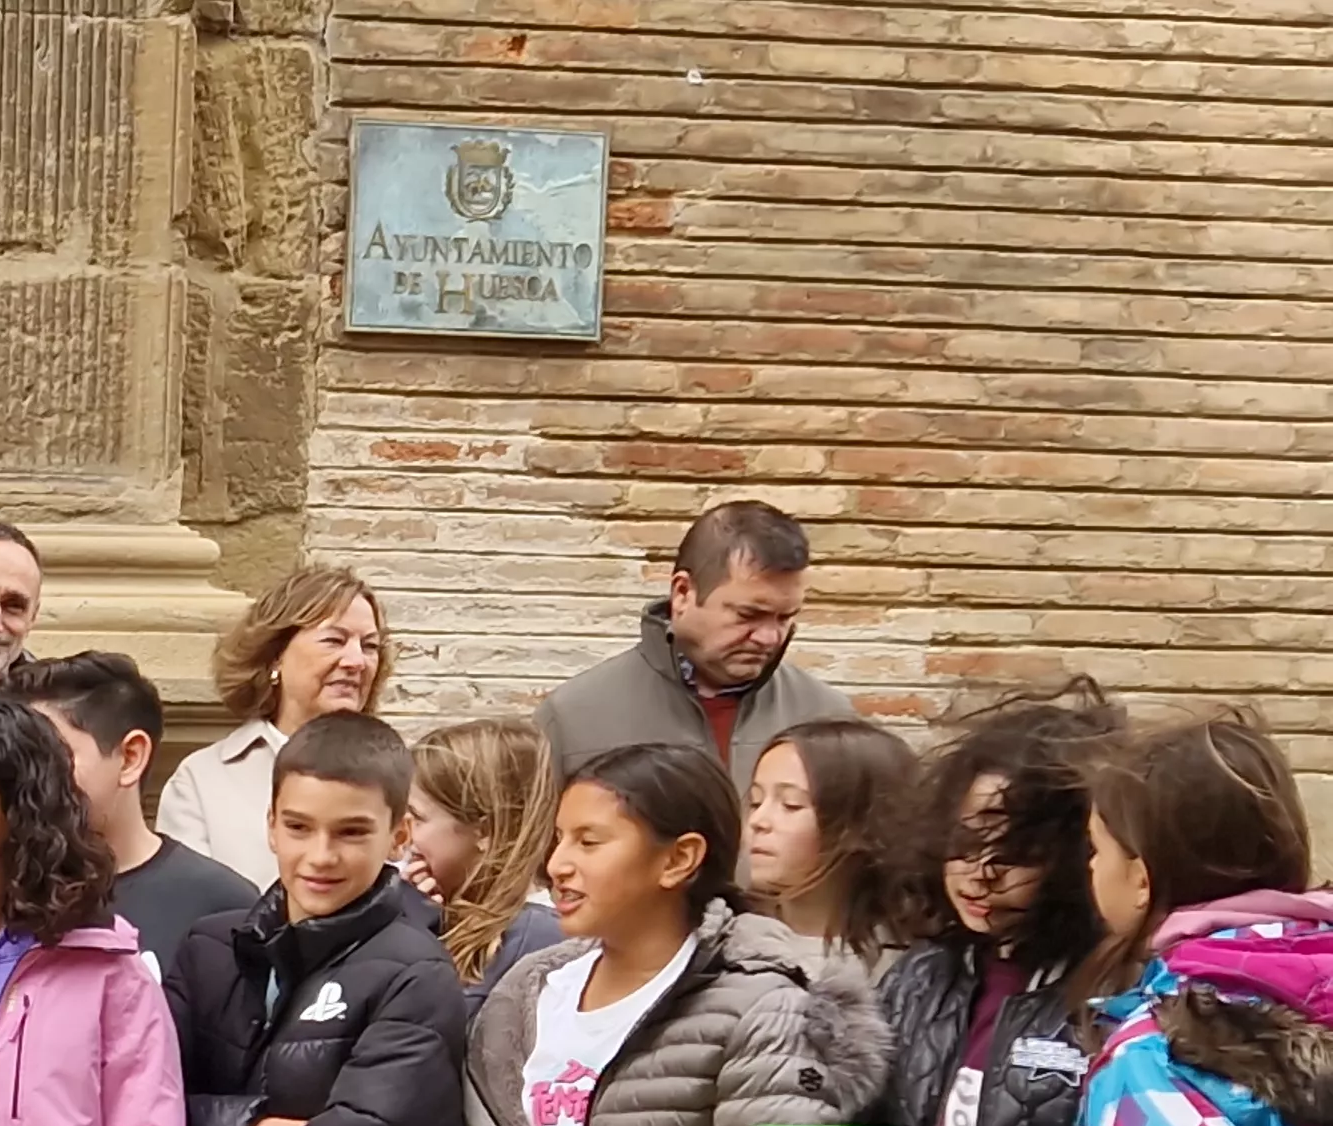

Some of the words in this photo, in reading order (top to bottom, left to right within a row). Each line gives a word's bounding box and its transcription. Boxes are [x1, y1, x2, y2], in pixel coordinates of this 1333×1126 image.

[362, 219, 594, 270] AYUNTAMIENTO
[392, 270, 423, 296] DE
[434, 269, 560, 315] HUESCA
